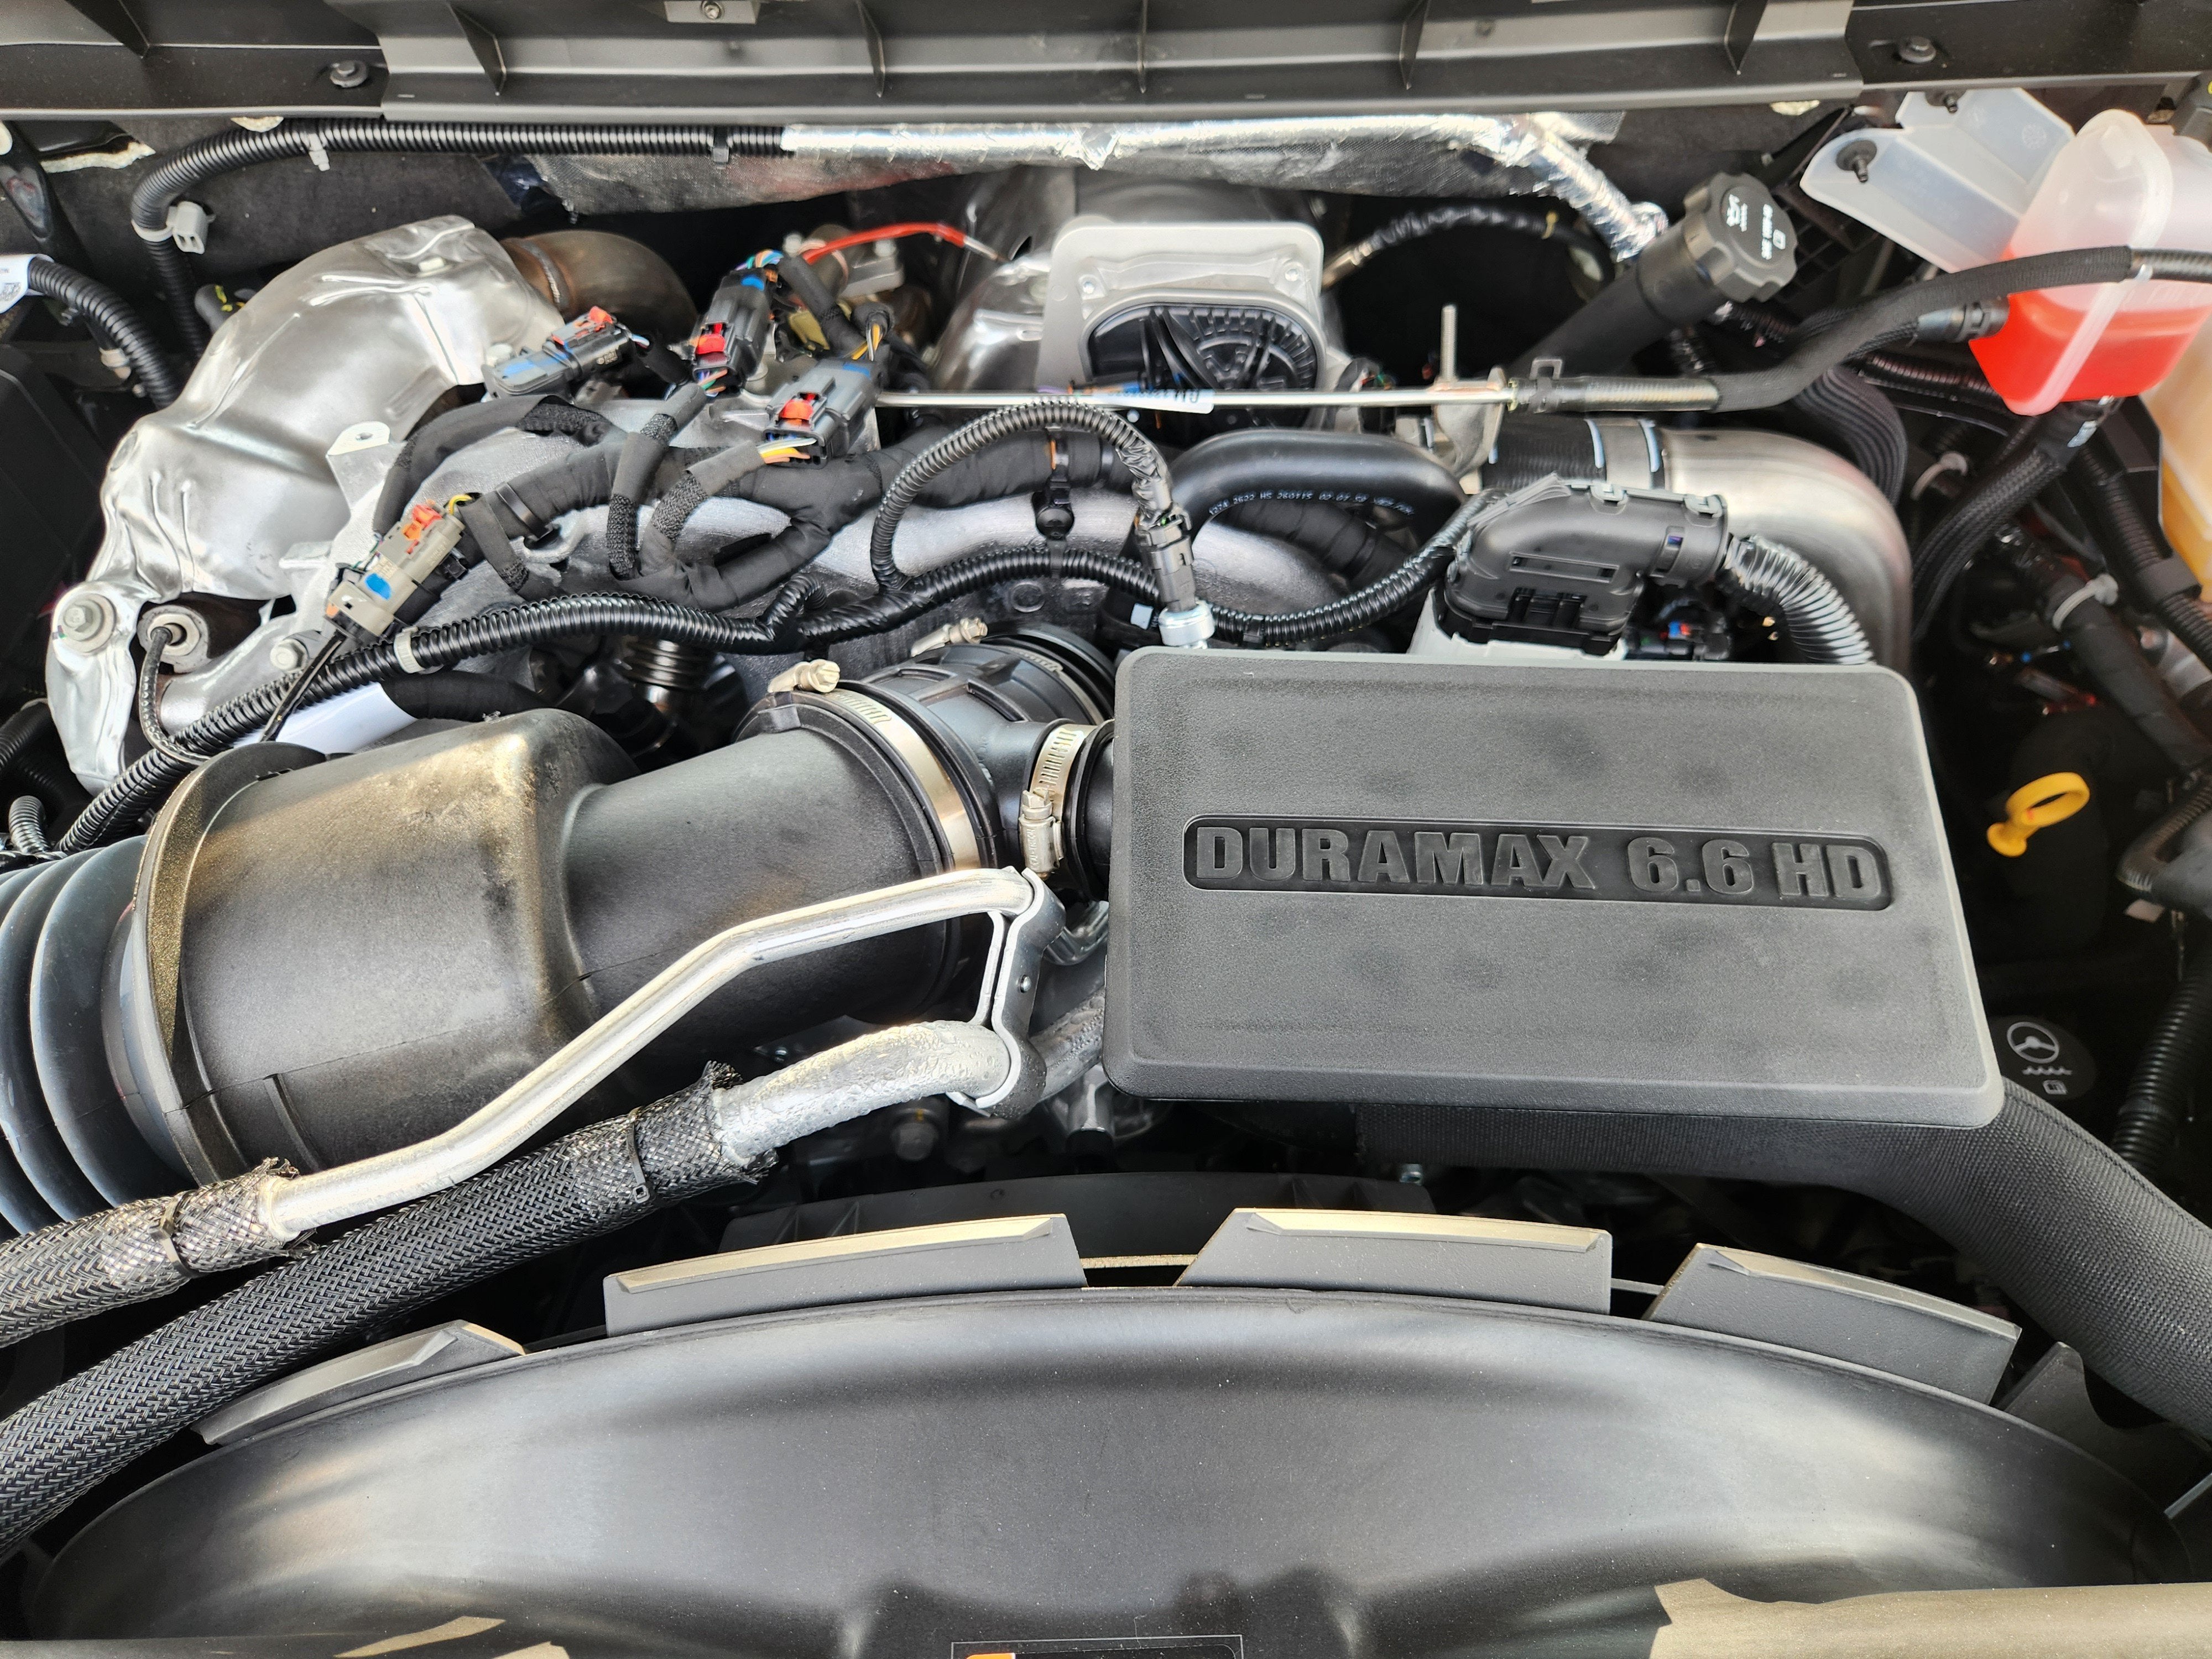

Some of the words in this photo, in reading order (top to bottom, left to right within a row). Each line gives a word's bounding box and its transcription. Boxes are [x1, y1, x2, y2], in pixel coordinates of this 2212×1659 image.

[1260, 489, 1273, 499] HS
[1196, 827, 1596, 890] DURAMAX
[1626, 836, 1754, 895] 6.6
[1771, 842, 1881, 899] HD
